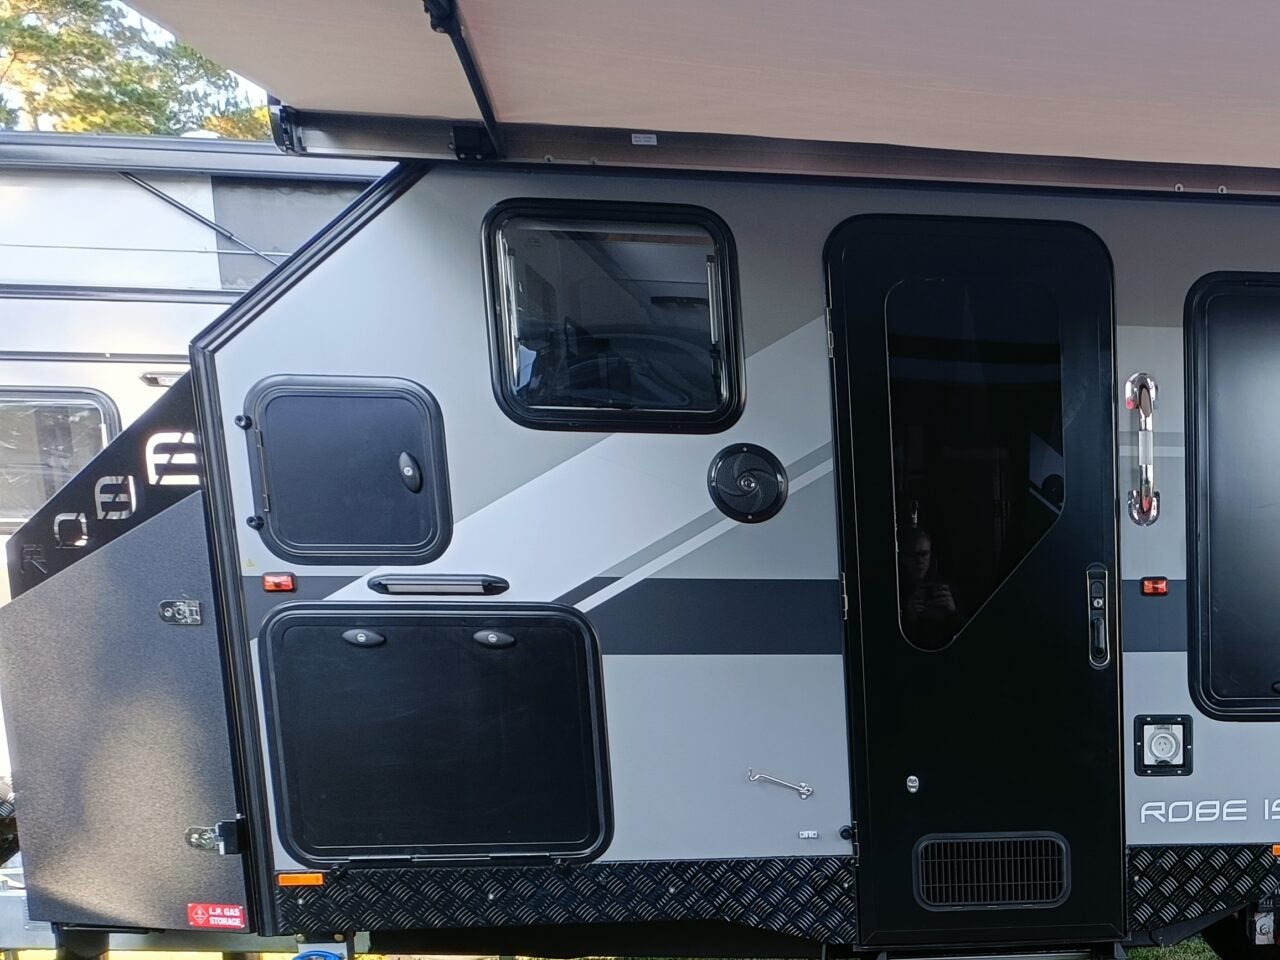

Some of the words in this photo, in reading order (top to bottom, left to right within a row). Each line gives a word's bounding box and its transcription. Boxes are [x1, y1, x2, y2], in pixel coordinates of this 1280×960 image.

[20, 432, 202, 574] ROBE
[1140, 799, 1248, 824] ROBE
[223, 907, 241, 917] GAS
[209, 917, 241, 926] STORAGE
